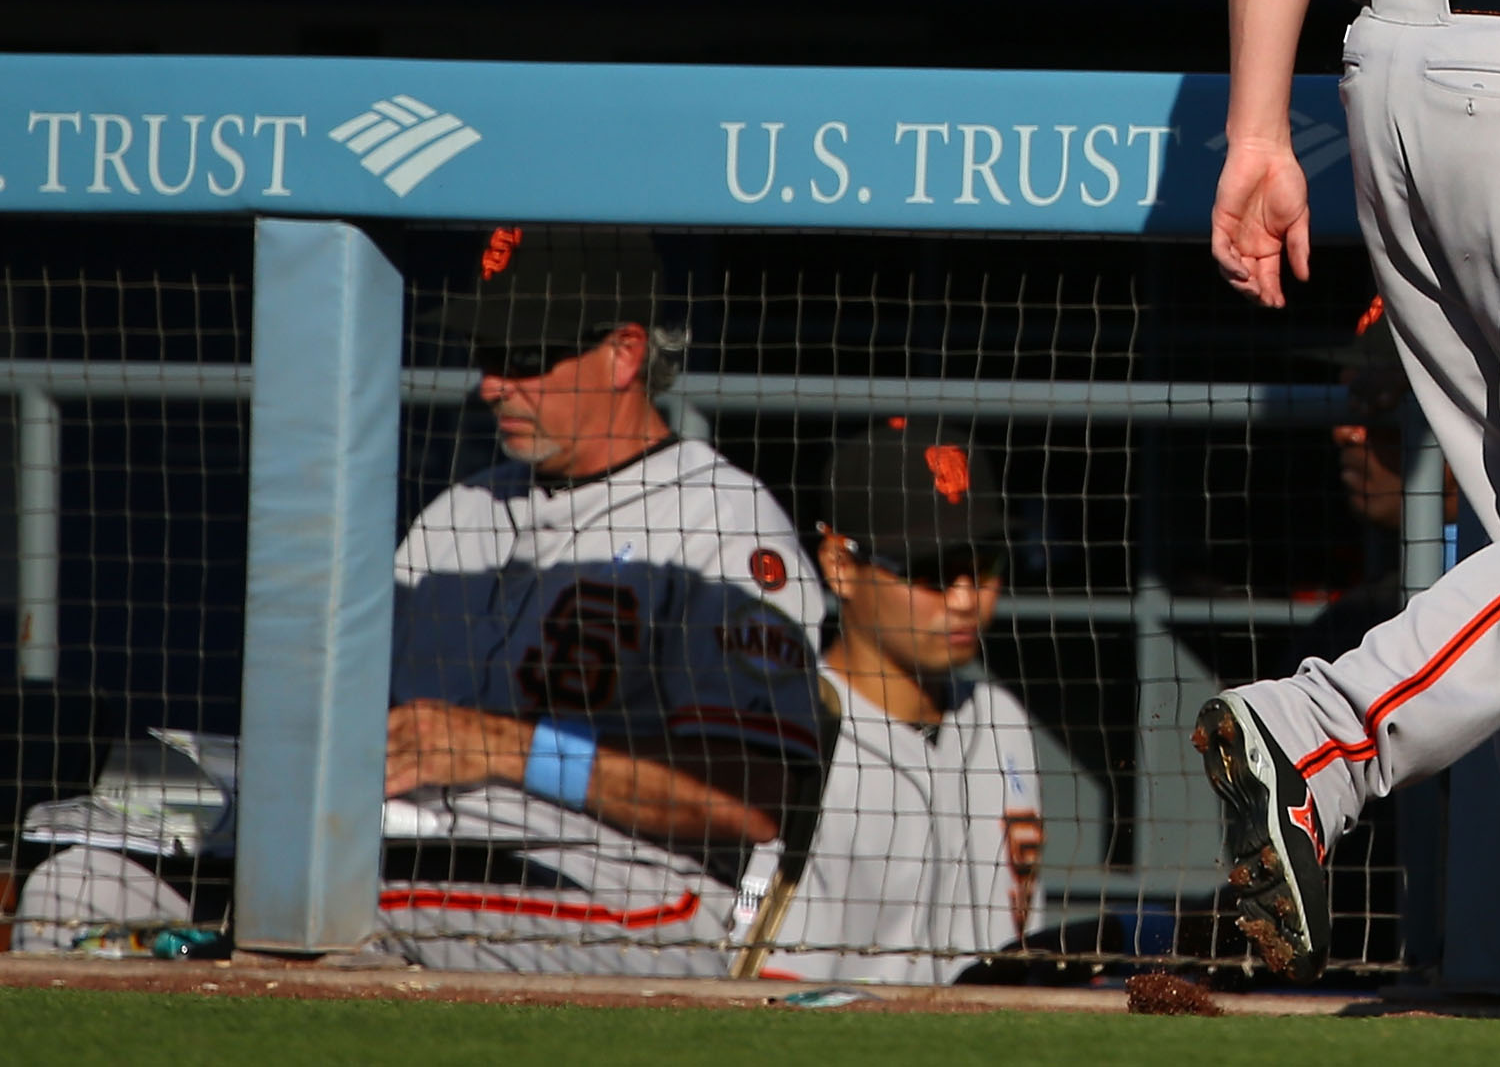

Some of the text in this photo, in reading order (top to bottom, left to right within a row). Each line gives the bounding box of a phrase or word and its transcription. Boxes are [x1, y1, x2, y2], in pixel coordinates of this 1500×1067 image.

[28, 111, 306, 197] TRUST
[720, 121, 1180, 207] U.S. TRUST
